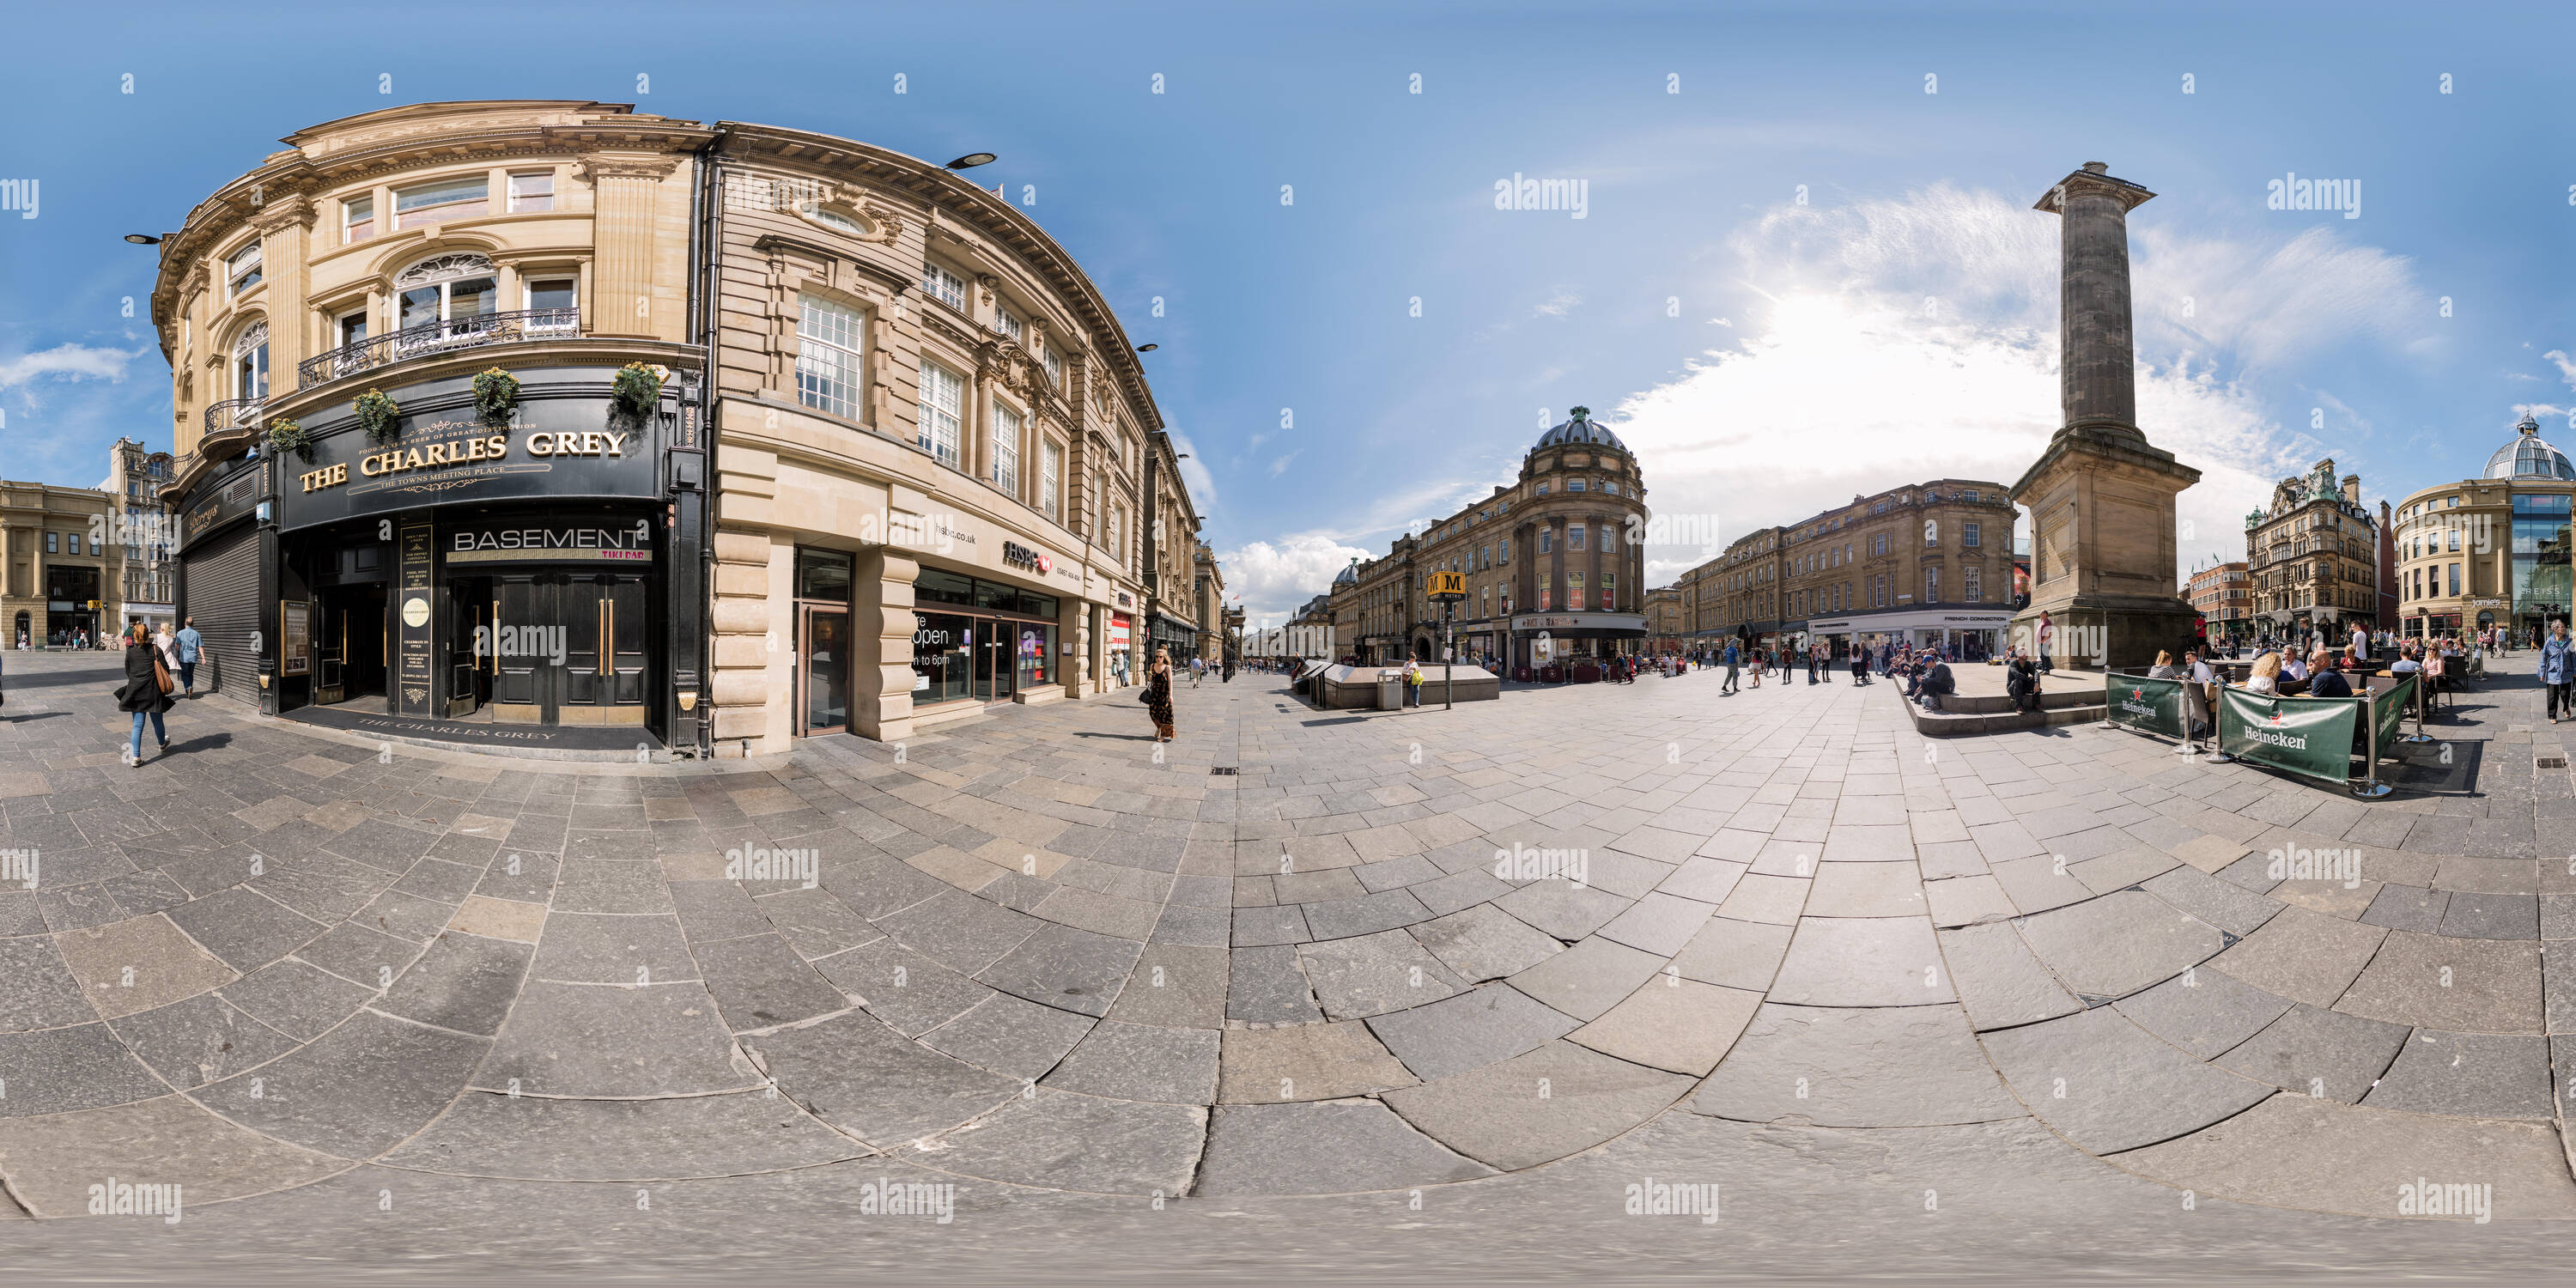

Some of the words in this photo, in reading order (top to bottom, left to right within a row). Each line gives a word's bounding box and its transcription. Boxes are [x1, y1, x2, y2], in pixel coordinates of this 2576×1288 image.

[359, 447, 377, 456] FOOD
[410, 435, 430, 445] BEER
[447, 429, 474, 438] GREAT
[300, 462, 349, 494] THE
[360, 435, 507, 477] CHARLES
[526, 431, 628, 458] GREY
[381, 480, 398, 489] THE
[398, 475, 428, 486] TOWNS
[429, 470, 471, 481] MEETING
[474, 466, 506, 476] PLACE
[454, 529, 645, 551] BASEMENT
[935, 523, 976, 545] hsbc.co.uk
[602, 550, 623, 560] TIKI
[624, 550, 645, 560] BAR
[1006, 541, 1040, 568] HSBC
[1430, 576, 1438, 592] M
[1445, 575, 1461, 590] M
[913, 629, 949, 648] open
[921, 655, 930, 665] to
[932, 654, 950, 667] 6pm
[2122, 700, 2156, 717] Heineken
[358, 718, 393, 728] THE
[395, 721, 489, 738] CHARLES
[495, 731, 557, 741] GREY
[2243, 726, 2306, 750] Heineken
